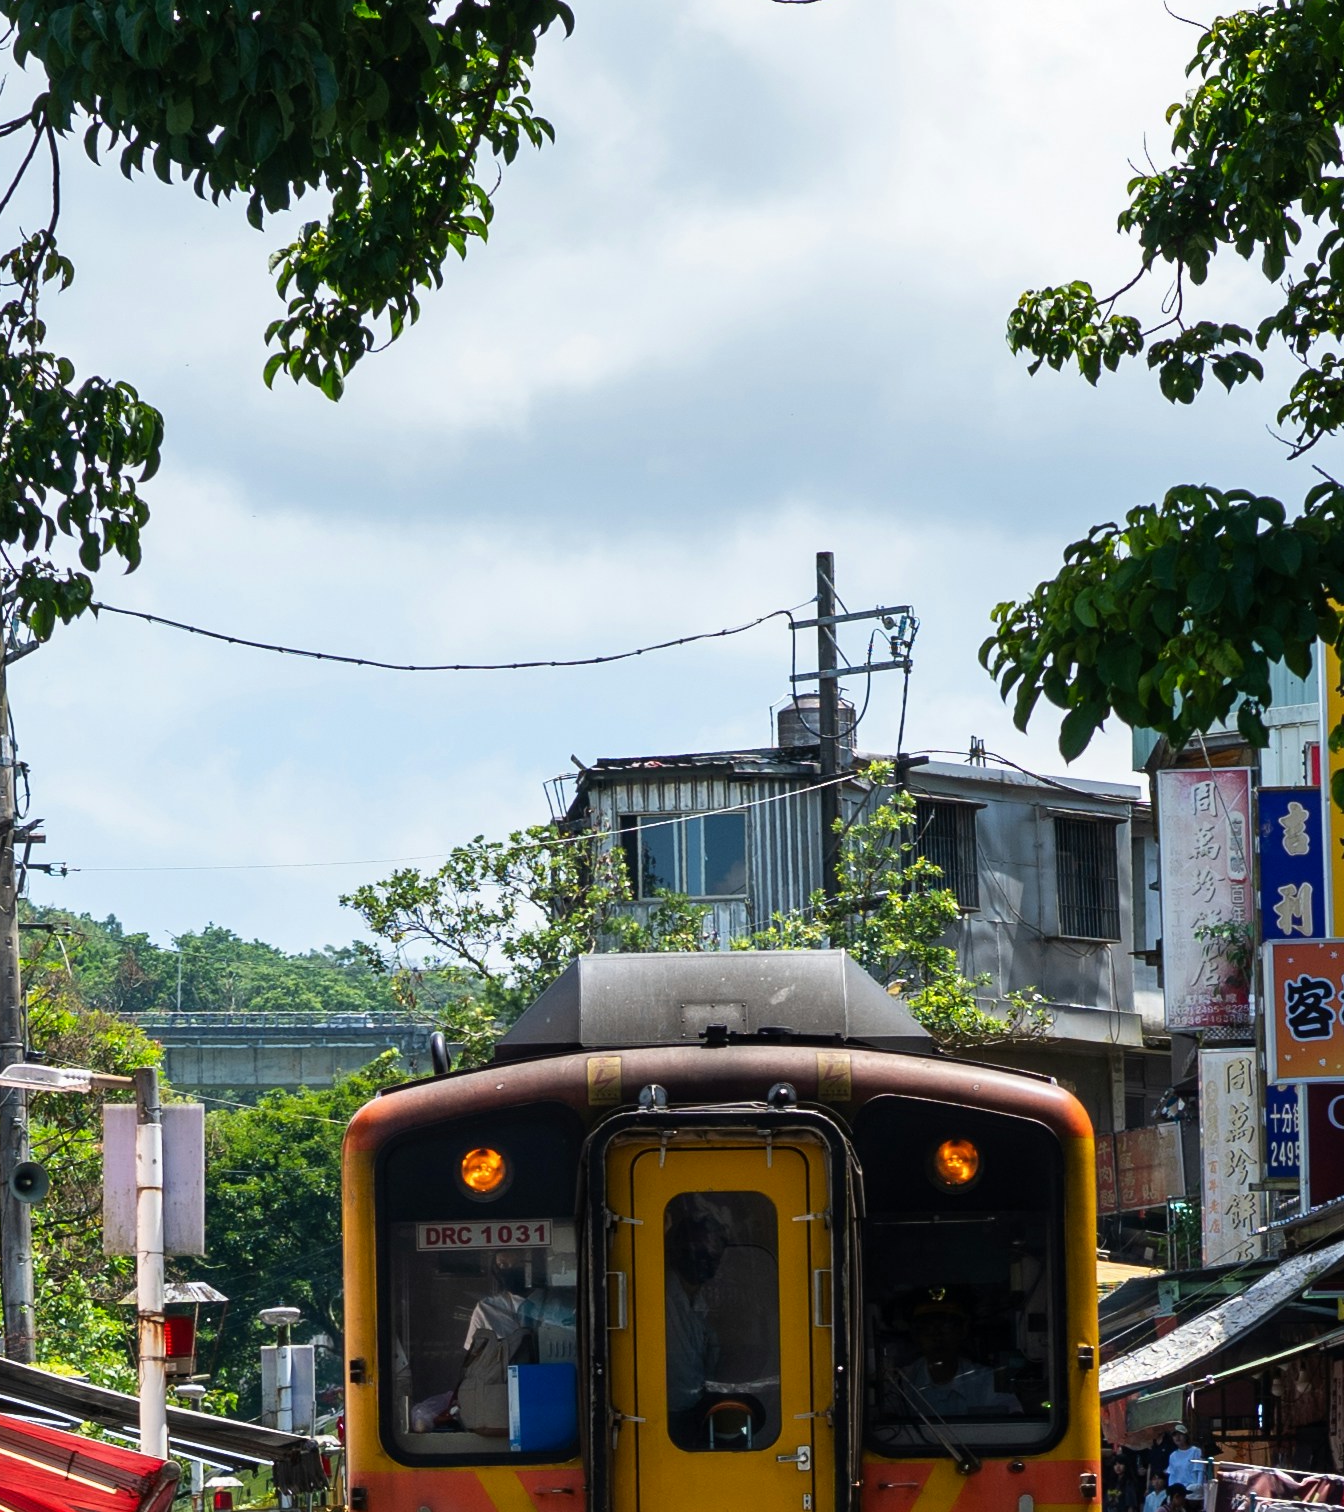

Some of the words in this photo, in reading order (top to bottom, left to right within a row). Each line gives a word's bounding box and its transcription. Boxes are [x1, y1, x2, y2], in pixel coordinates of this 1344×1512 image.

[1273, 801, 1314, 937] 吉利
[426, 1225, 472, 1246] DRC
[480, 1223, 547, 1244] 1031
